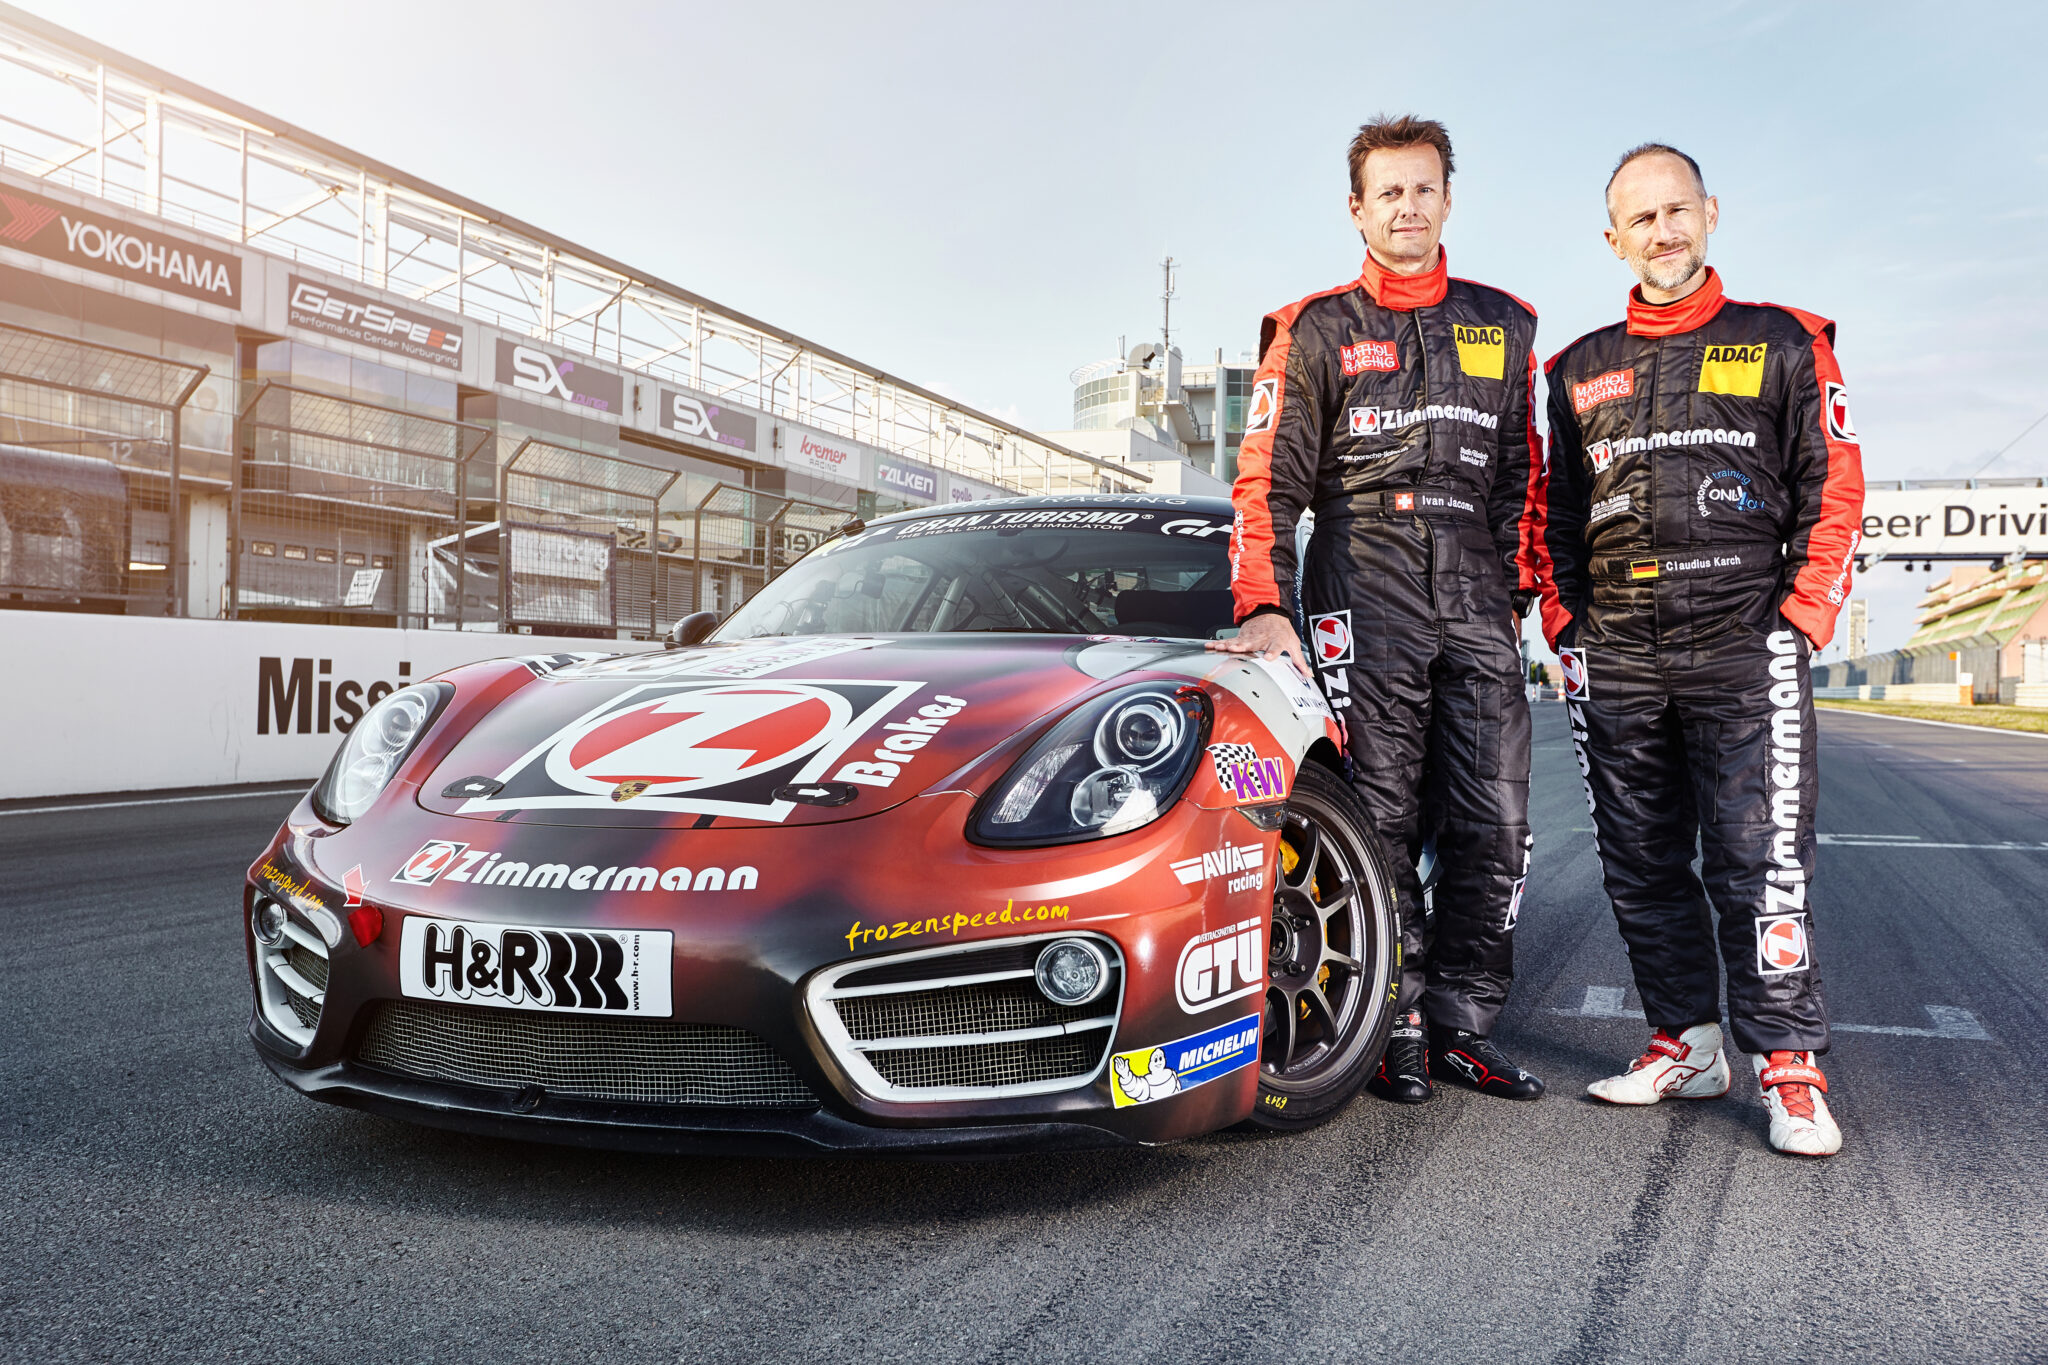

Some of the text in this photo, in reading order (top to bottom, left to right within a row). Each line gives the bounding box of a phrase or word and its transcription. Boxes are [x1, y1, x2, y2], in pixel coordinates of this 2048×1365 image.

[60, 216, 232, 297] YOKOHAMA
[291, 311, 459, 368] Performance Center Nürburgring
[1456, 327, 1502, 346] ADAC
[1343, 343, 1393, 360] MATHOL
[1344, 356, 1395, 373] RACING
[1706, 345, 1763, 363] ADAC
[1575, 373, 1630, 398] MATHOL
[1576, 383, 1630, 410] RACING
[1380, 404, 1498, 430] Zimmermann
[799, 434, 847, 465] kremer
[1611, 428, 1756, 457] Zimmermann
[809, 458, 837, 472] RACING
[1712, 468, 1751, 486] training
[878, 464, 934, 494] FALKEN
[952, 488, 972, 503] apollo
[1039, 496, 1188, 505] RACING
[1422, 495, 1475, 513] Ivan Jacoma
[1697, 475, 1714, 518] personal
[895, 523, 1124, 540] THE REAL DRIVING SIMULATOR
[898, 514, 992, 536] GRAN
[1862, 503, 2048, 538] eer Drivi
[1665, 555, 1741, 572] Claudius Karch
[832, 694, 968, 787] Brakes
[1228, 757, 1287, 803] KW
[1765, 629, 1806, 913] Zimmermann
[444, 851, 760, 892] Zimmermann
[1228, 872, 1263, 894] racing
[844, 898, 1070, 952] frozenspeed.com
[631, 934, 641, 1012] www.h-r.com
[1177, 1026, 1259, 1071] MICHELIN
